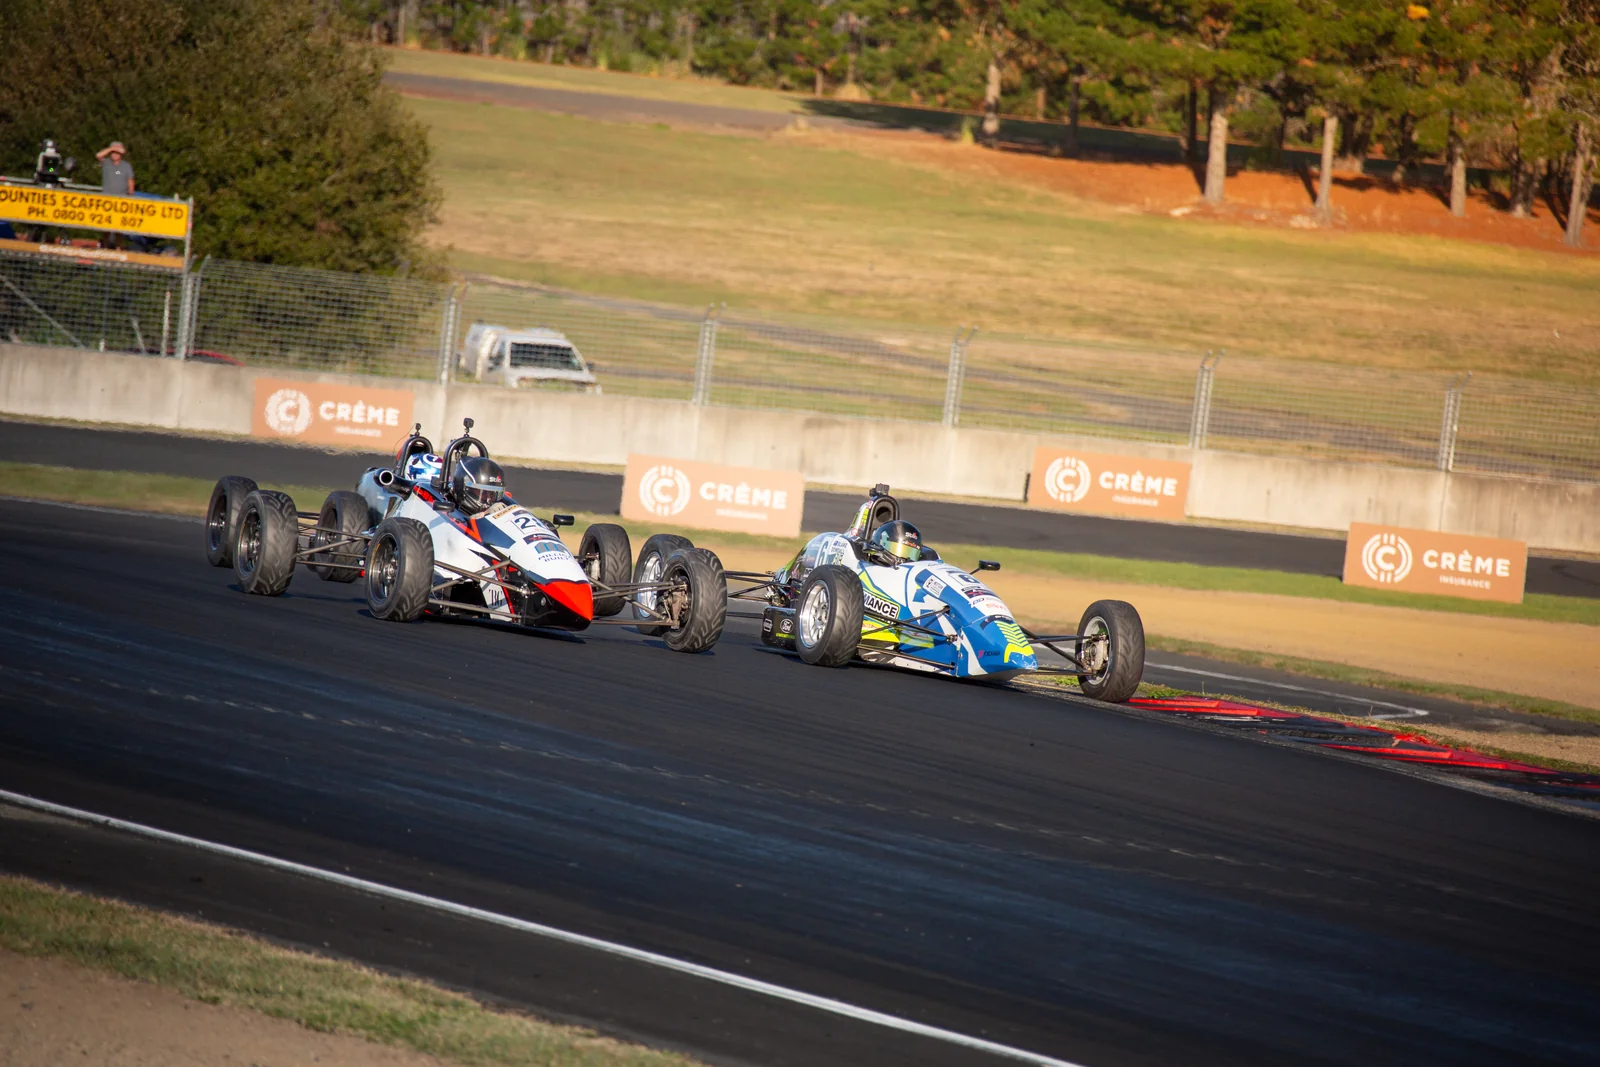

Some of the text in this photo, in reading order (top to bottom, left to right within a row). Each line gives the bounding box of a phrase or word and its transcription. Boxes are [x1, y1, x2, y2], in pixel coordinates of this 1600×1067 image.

[28, 206, 144, 228] PH. 0800 924 807
[62, 196, 156, 216] SCAFFOLDING
[161, 206, 184, 219] LTD
[1439, 575, 1491, 590] INSURANCE
